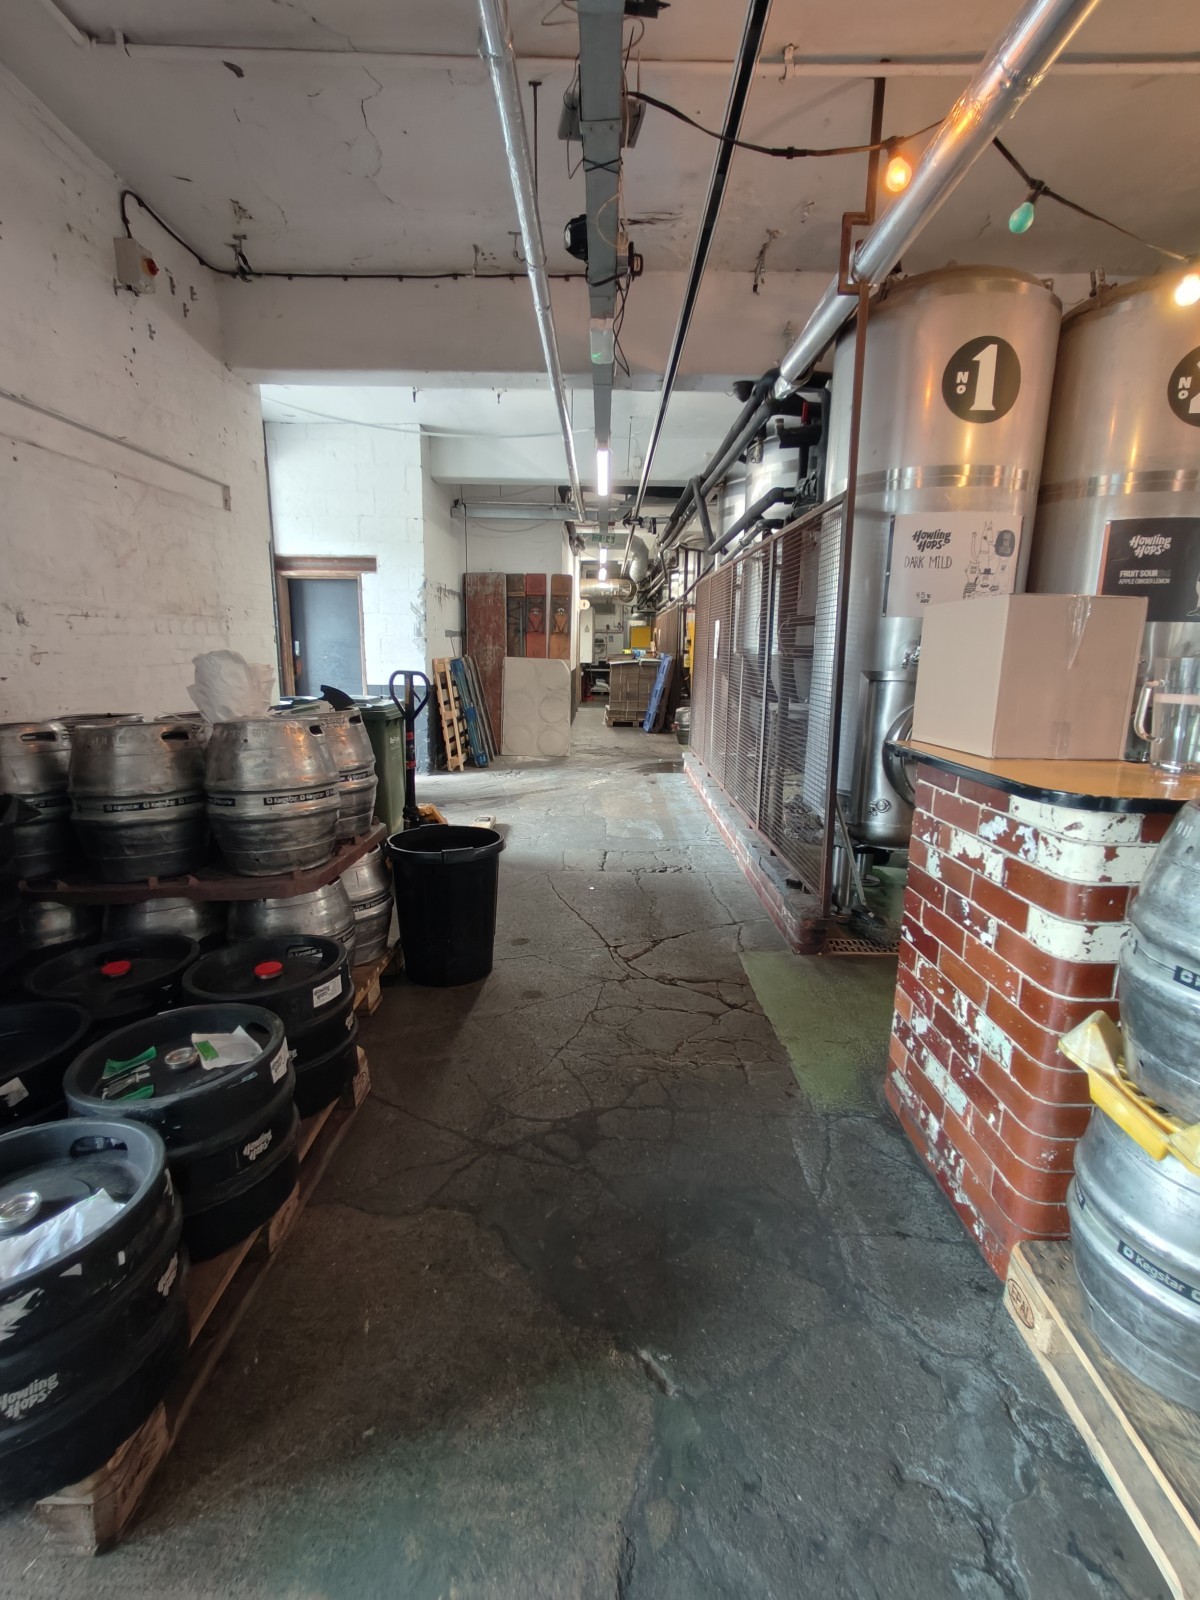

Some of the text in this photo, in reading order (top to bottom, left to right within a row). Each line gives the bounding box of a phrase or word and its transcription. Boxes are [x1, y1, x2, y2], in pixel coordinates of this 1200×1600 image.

[969, 344, 998, 411] 1
[904, 556, 953, 569] DARK MILD
[1119, 570, 1140, 578] FRUIT
[1140, 569, 1159, 577] SOUR
[1135, 1254, 1186, 1292] Kegstar
